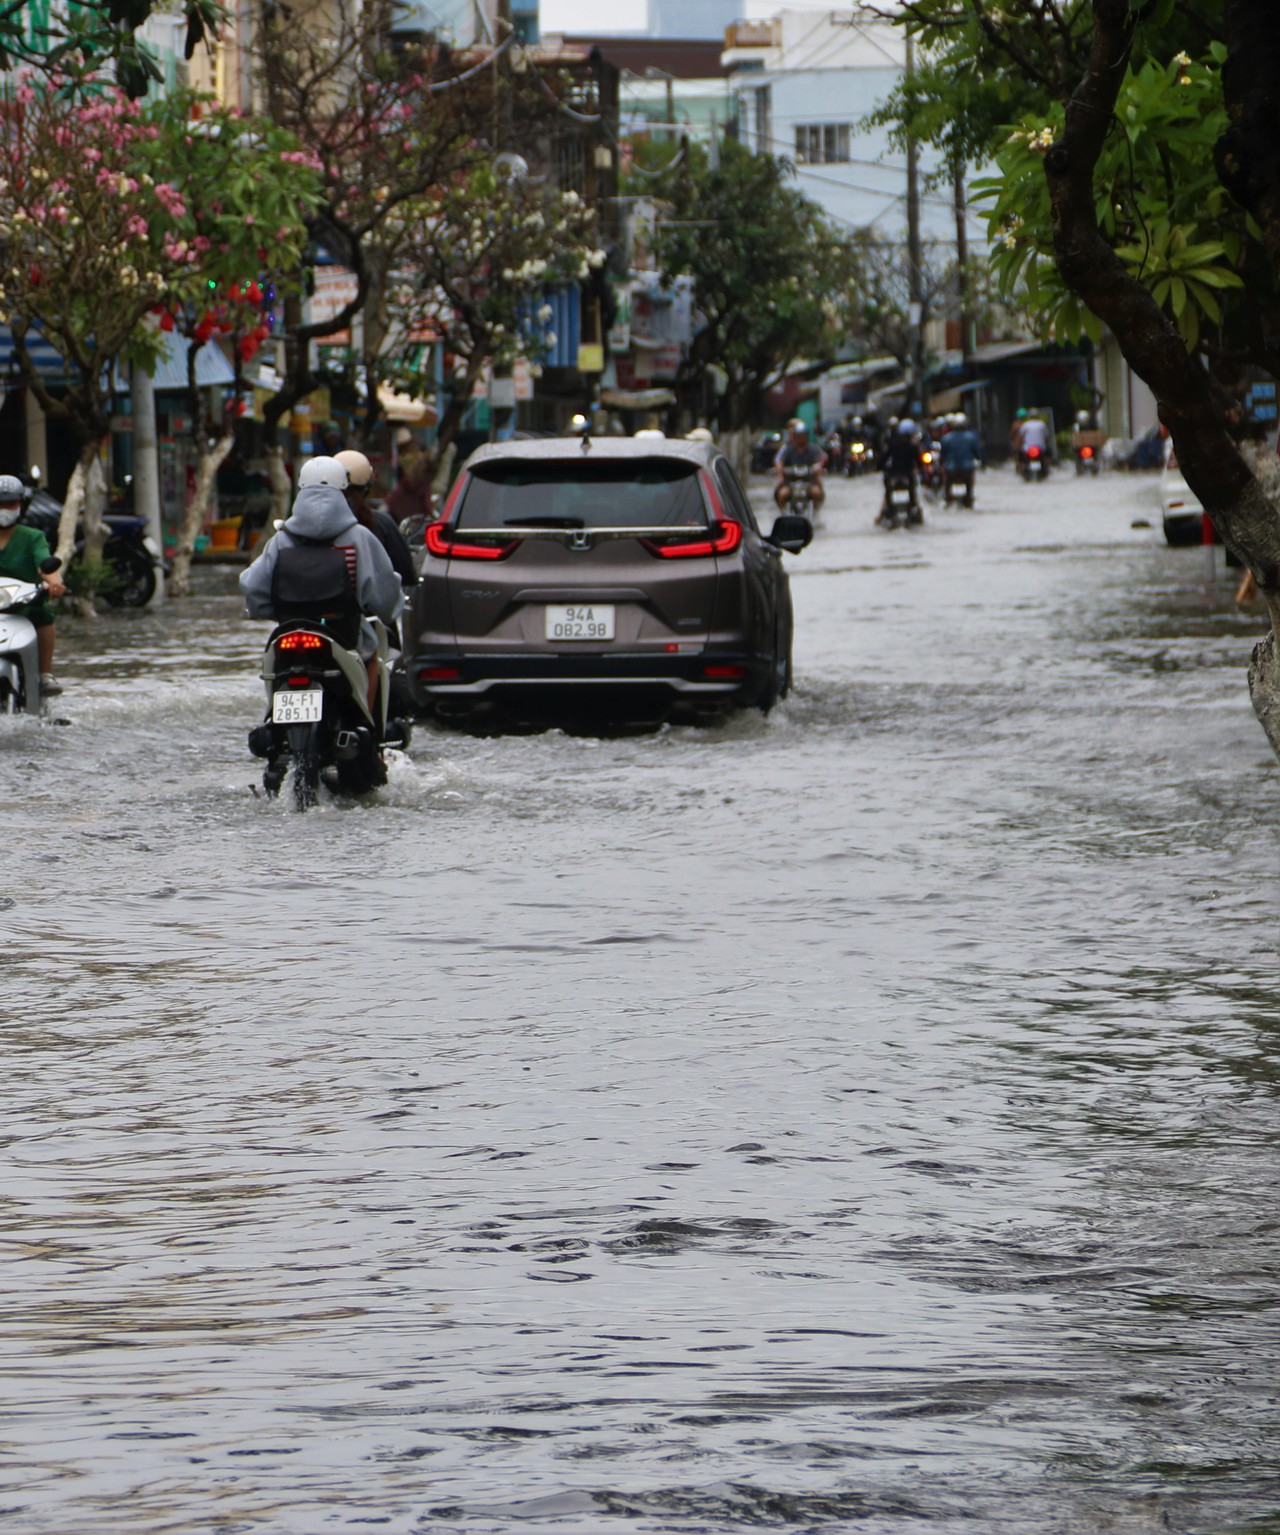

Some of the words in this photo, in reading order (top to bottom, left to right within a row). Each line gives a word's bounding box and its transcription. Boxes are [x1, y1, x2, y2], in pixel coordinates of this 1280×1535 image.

[566, 607, 594, 621] 94A
[554, 623, 606, 637] 082.98
[281, 693, 314, 707] 94-F1
[277, 707, 318, 721] 285.11
